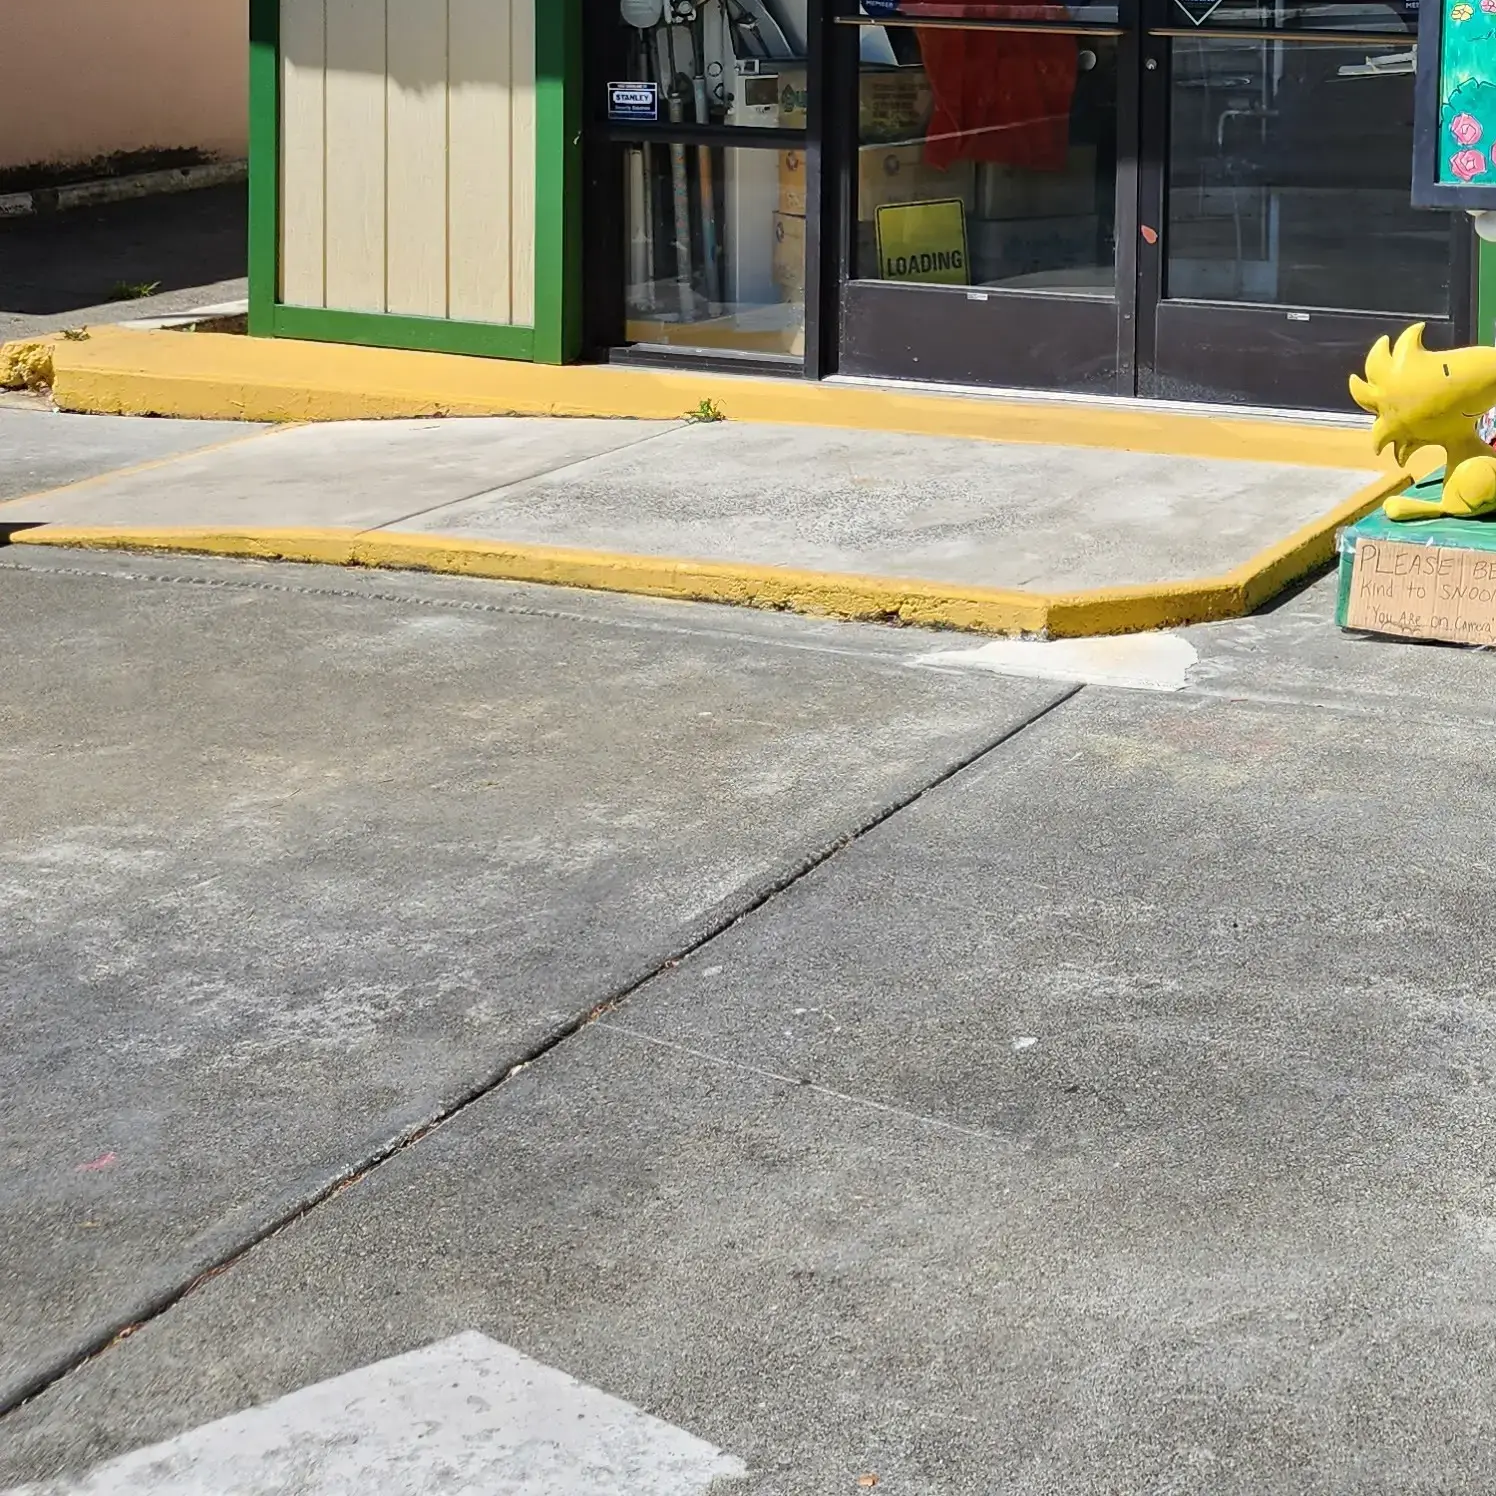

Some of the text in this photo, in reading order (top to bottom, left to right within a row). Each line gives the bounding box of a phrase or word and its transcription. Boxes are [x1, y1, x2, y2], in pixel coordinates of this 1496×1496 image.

[887, 250, 963, 277] LOADING
[1360, 544, 1454, 576] PLEASE
[1407, 581, 1426, 599] to
